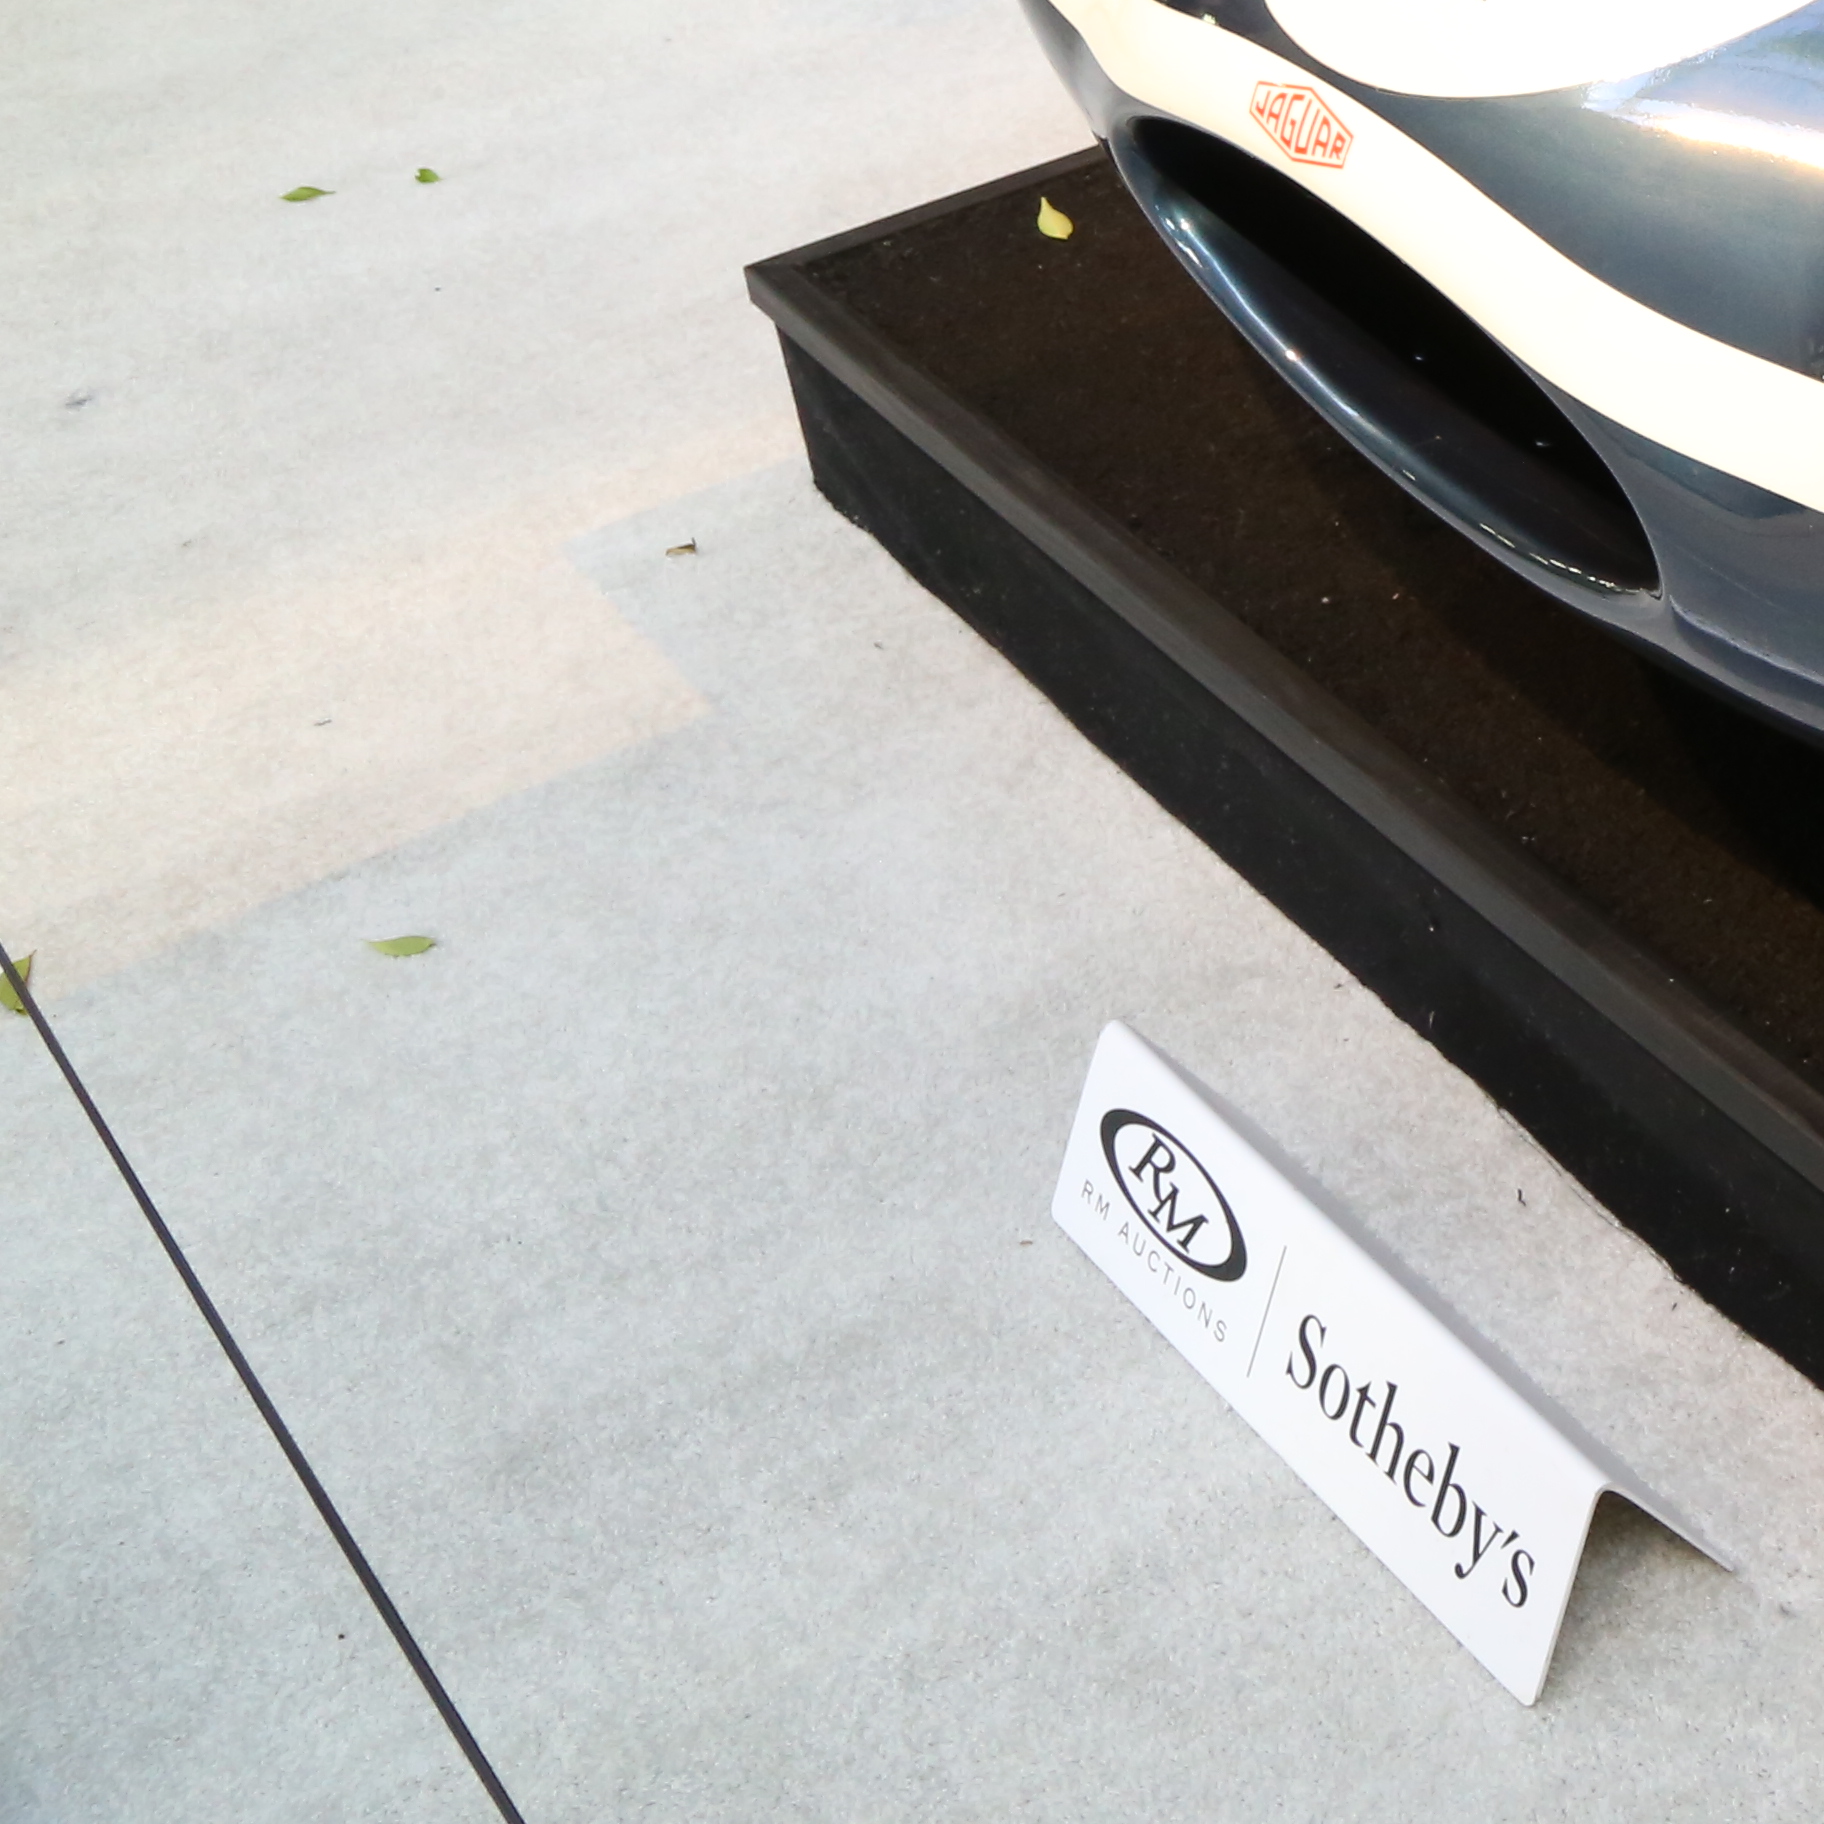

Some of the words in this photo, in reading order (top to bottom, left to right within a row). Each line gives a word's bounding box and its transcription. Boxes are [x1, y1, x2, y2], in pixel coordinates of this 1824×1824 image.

[1254, 89, 1347, 161] JAGUAR
[1080, 1178, 1111, 1222] RM
[1117, 1220, 1228, 1344] AUCTIONS
[1285, 1313, 1537, 1609] Sotheby's
